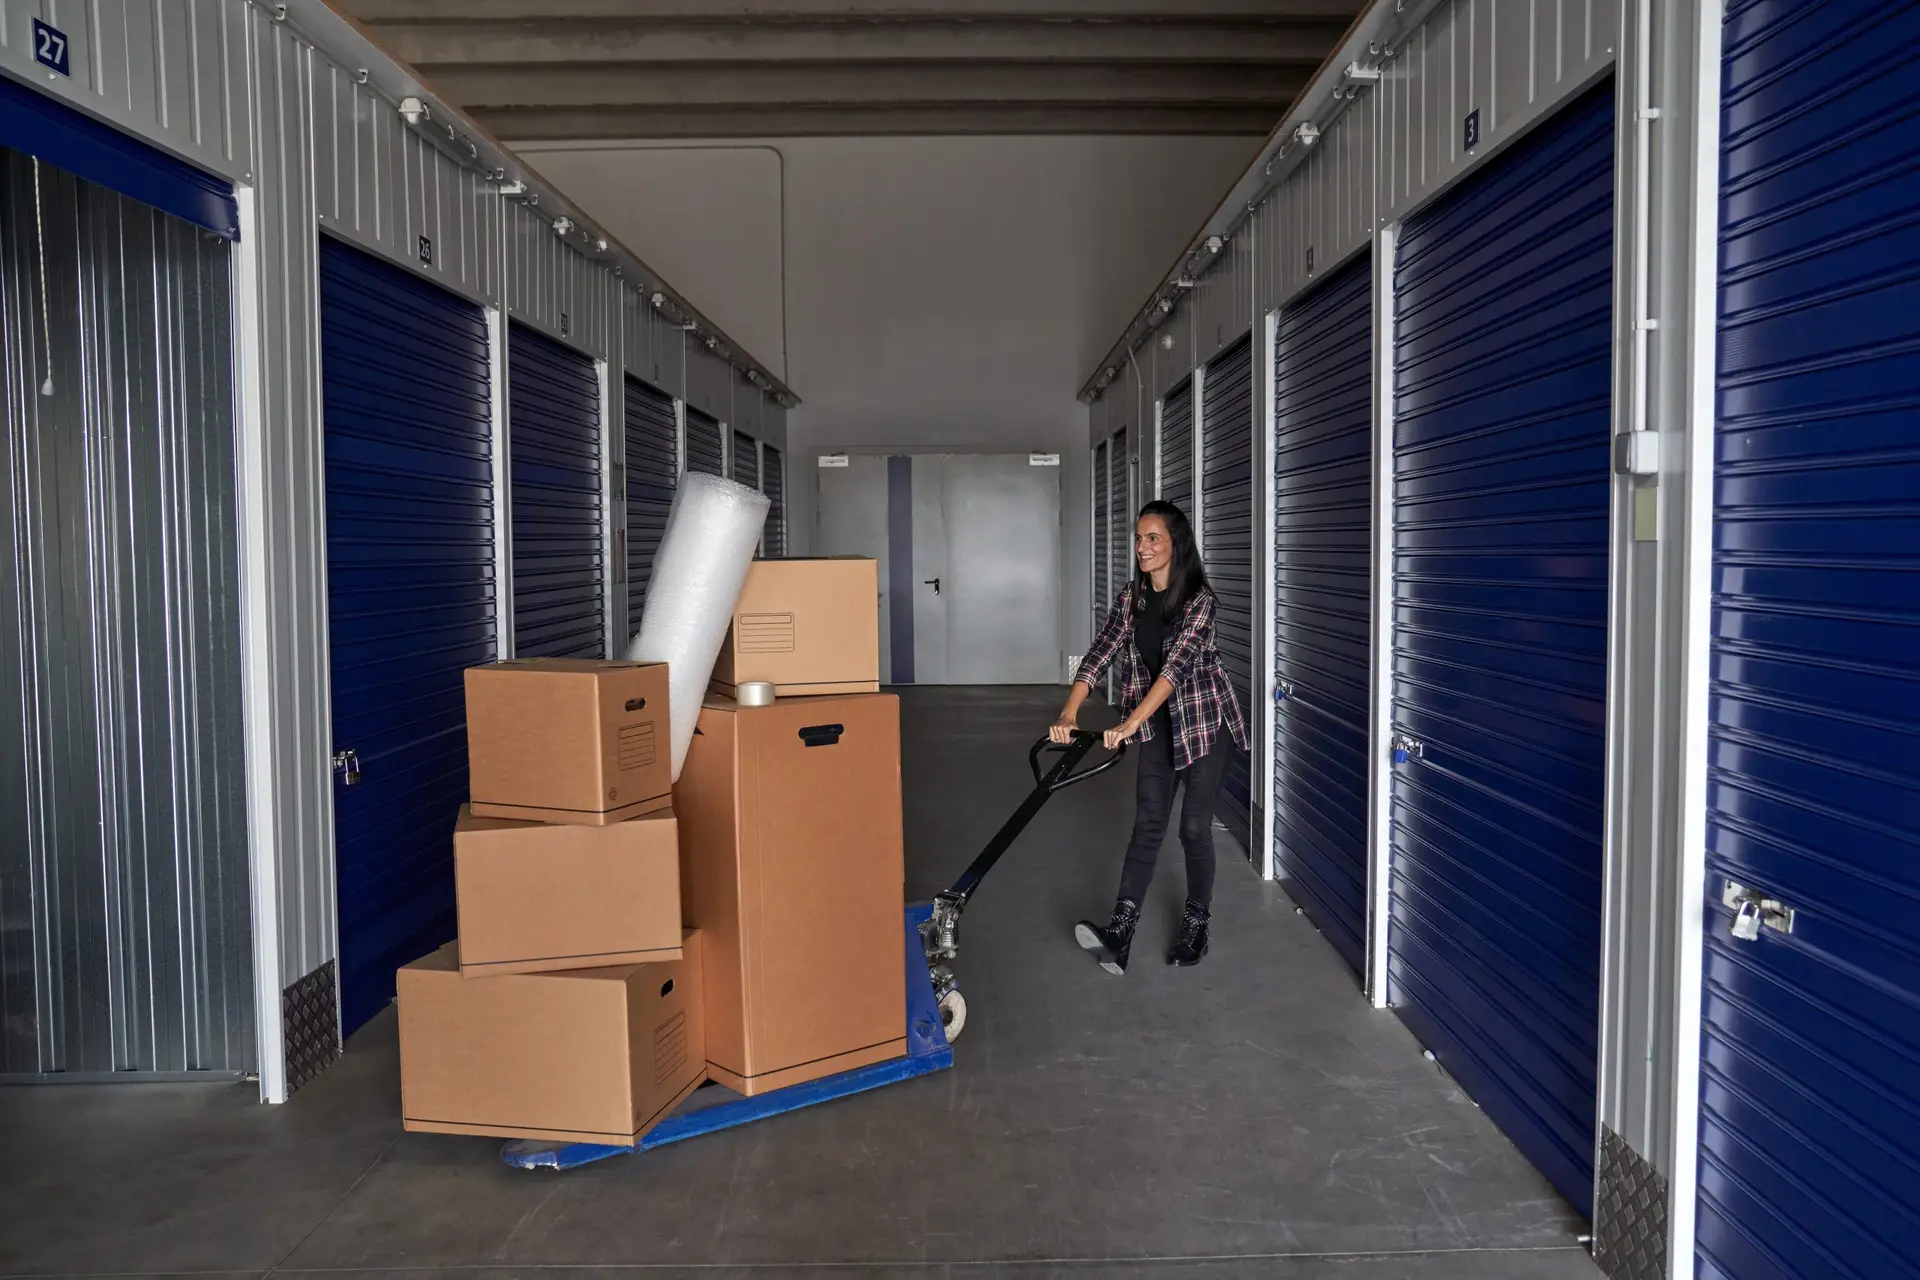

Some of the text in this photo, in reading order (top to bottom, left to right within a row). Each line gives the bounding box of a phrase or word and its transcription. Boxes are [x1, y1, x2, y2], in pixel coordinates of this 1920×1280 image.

[38, 28, 65, 65] 27
[1468, 118, 1475, 142] 3
[420, 240, 430, 260] 26
